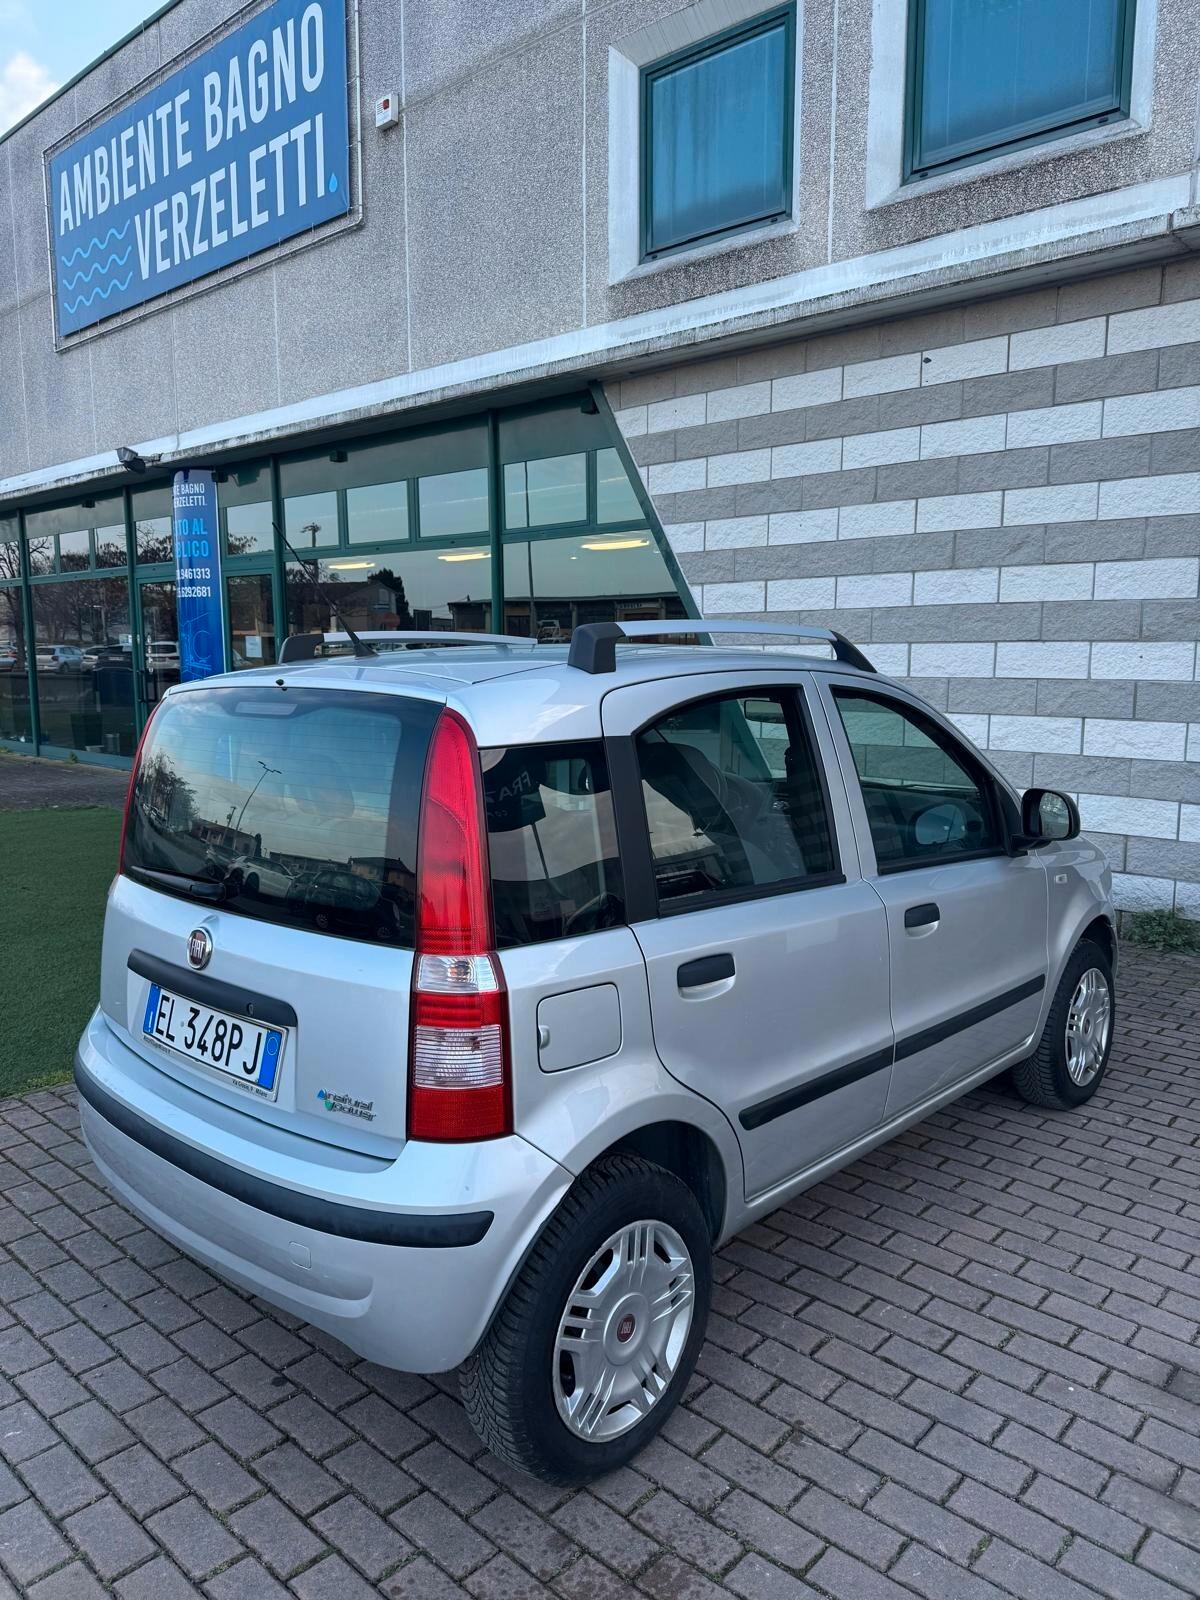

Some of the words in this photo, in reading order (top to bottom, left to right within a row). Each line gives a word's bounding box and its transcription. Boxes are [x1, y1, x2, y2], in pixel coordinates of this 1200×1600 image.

[60, 89, 192, 236] AMBIENTE
[203, 2, 324, 151] BAGNO
[181, 483, 205, 494] BAGNO
[192, 518, 208, 535] AL
[191, 938, 205, 959] FIAT
[155, 994, 176, 1043] EL
[184, 1006, 262, 1075] 348PJ
[327, 1092, 374, 1111] natural
